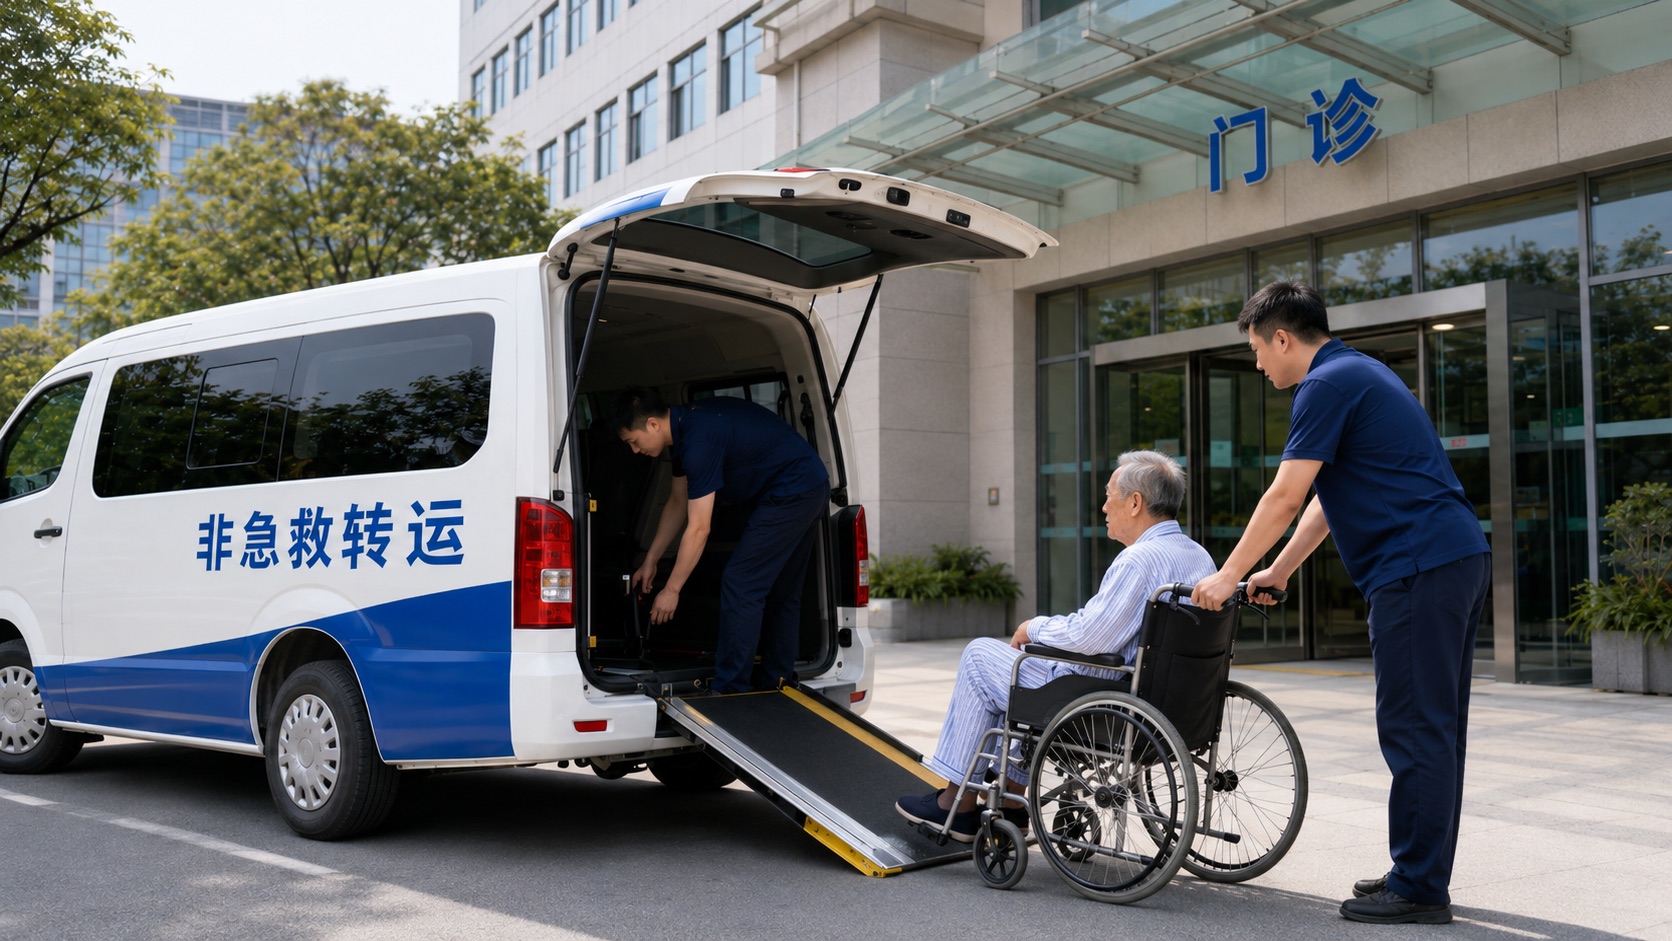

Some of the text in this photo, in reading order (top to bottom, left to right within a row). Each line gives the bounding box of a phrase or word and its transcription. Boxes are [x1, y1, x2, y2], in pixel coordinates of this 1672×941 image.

[1209, 77, 1380, 193] 门诊
[196, 499, 465, 571] 非急救转运
